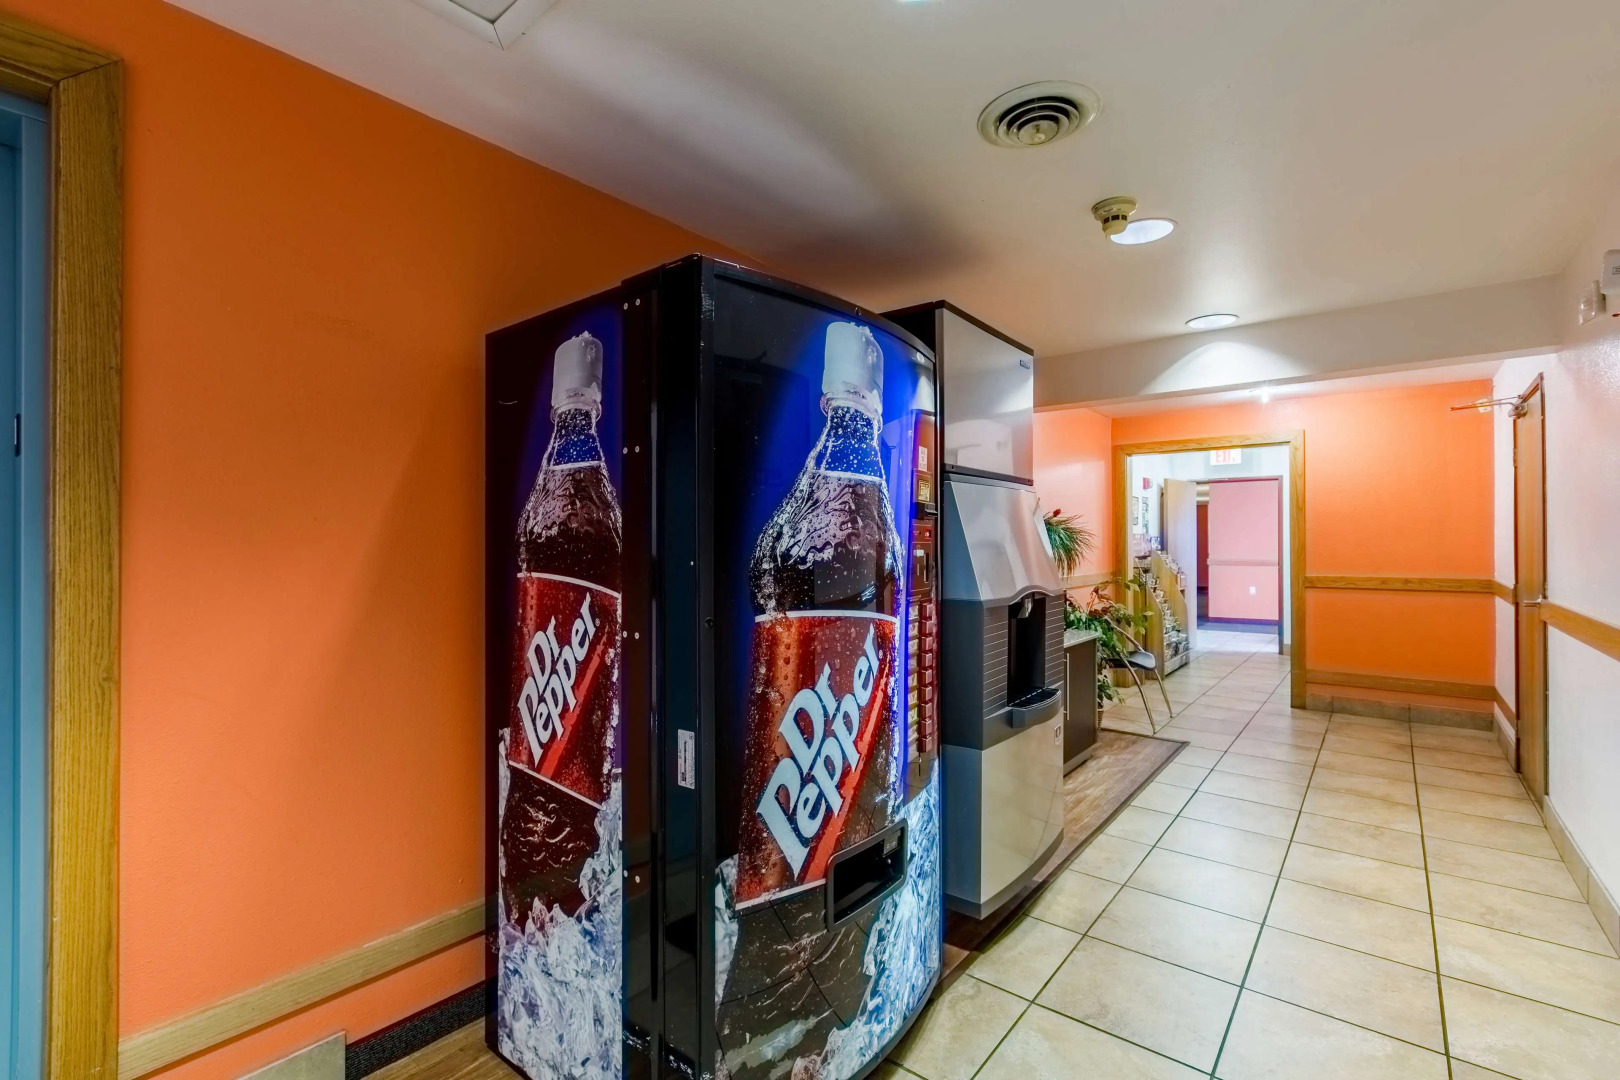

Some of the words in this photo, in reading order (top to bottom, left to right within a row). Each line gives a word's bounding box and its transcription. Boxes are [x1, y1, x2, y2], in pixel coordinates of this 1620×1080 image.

[518, 592, 596, 768] Pepper
[527, 615, 561, 696] Dr
[778, 662, 839, 777] Dr
[756, 623, 880, 881] Pepper
